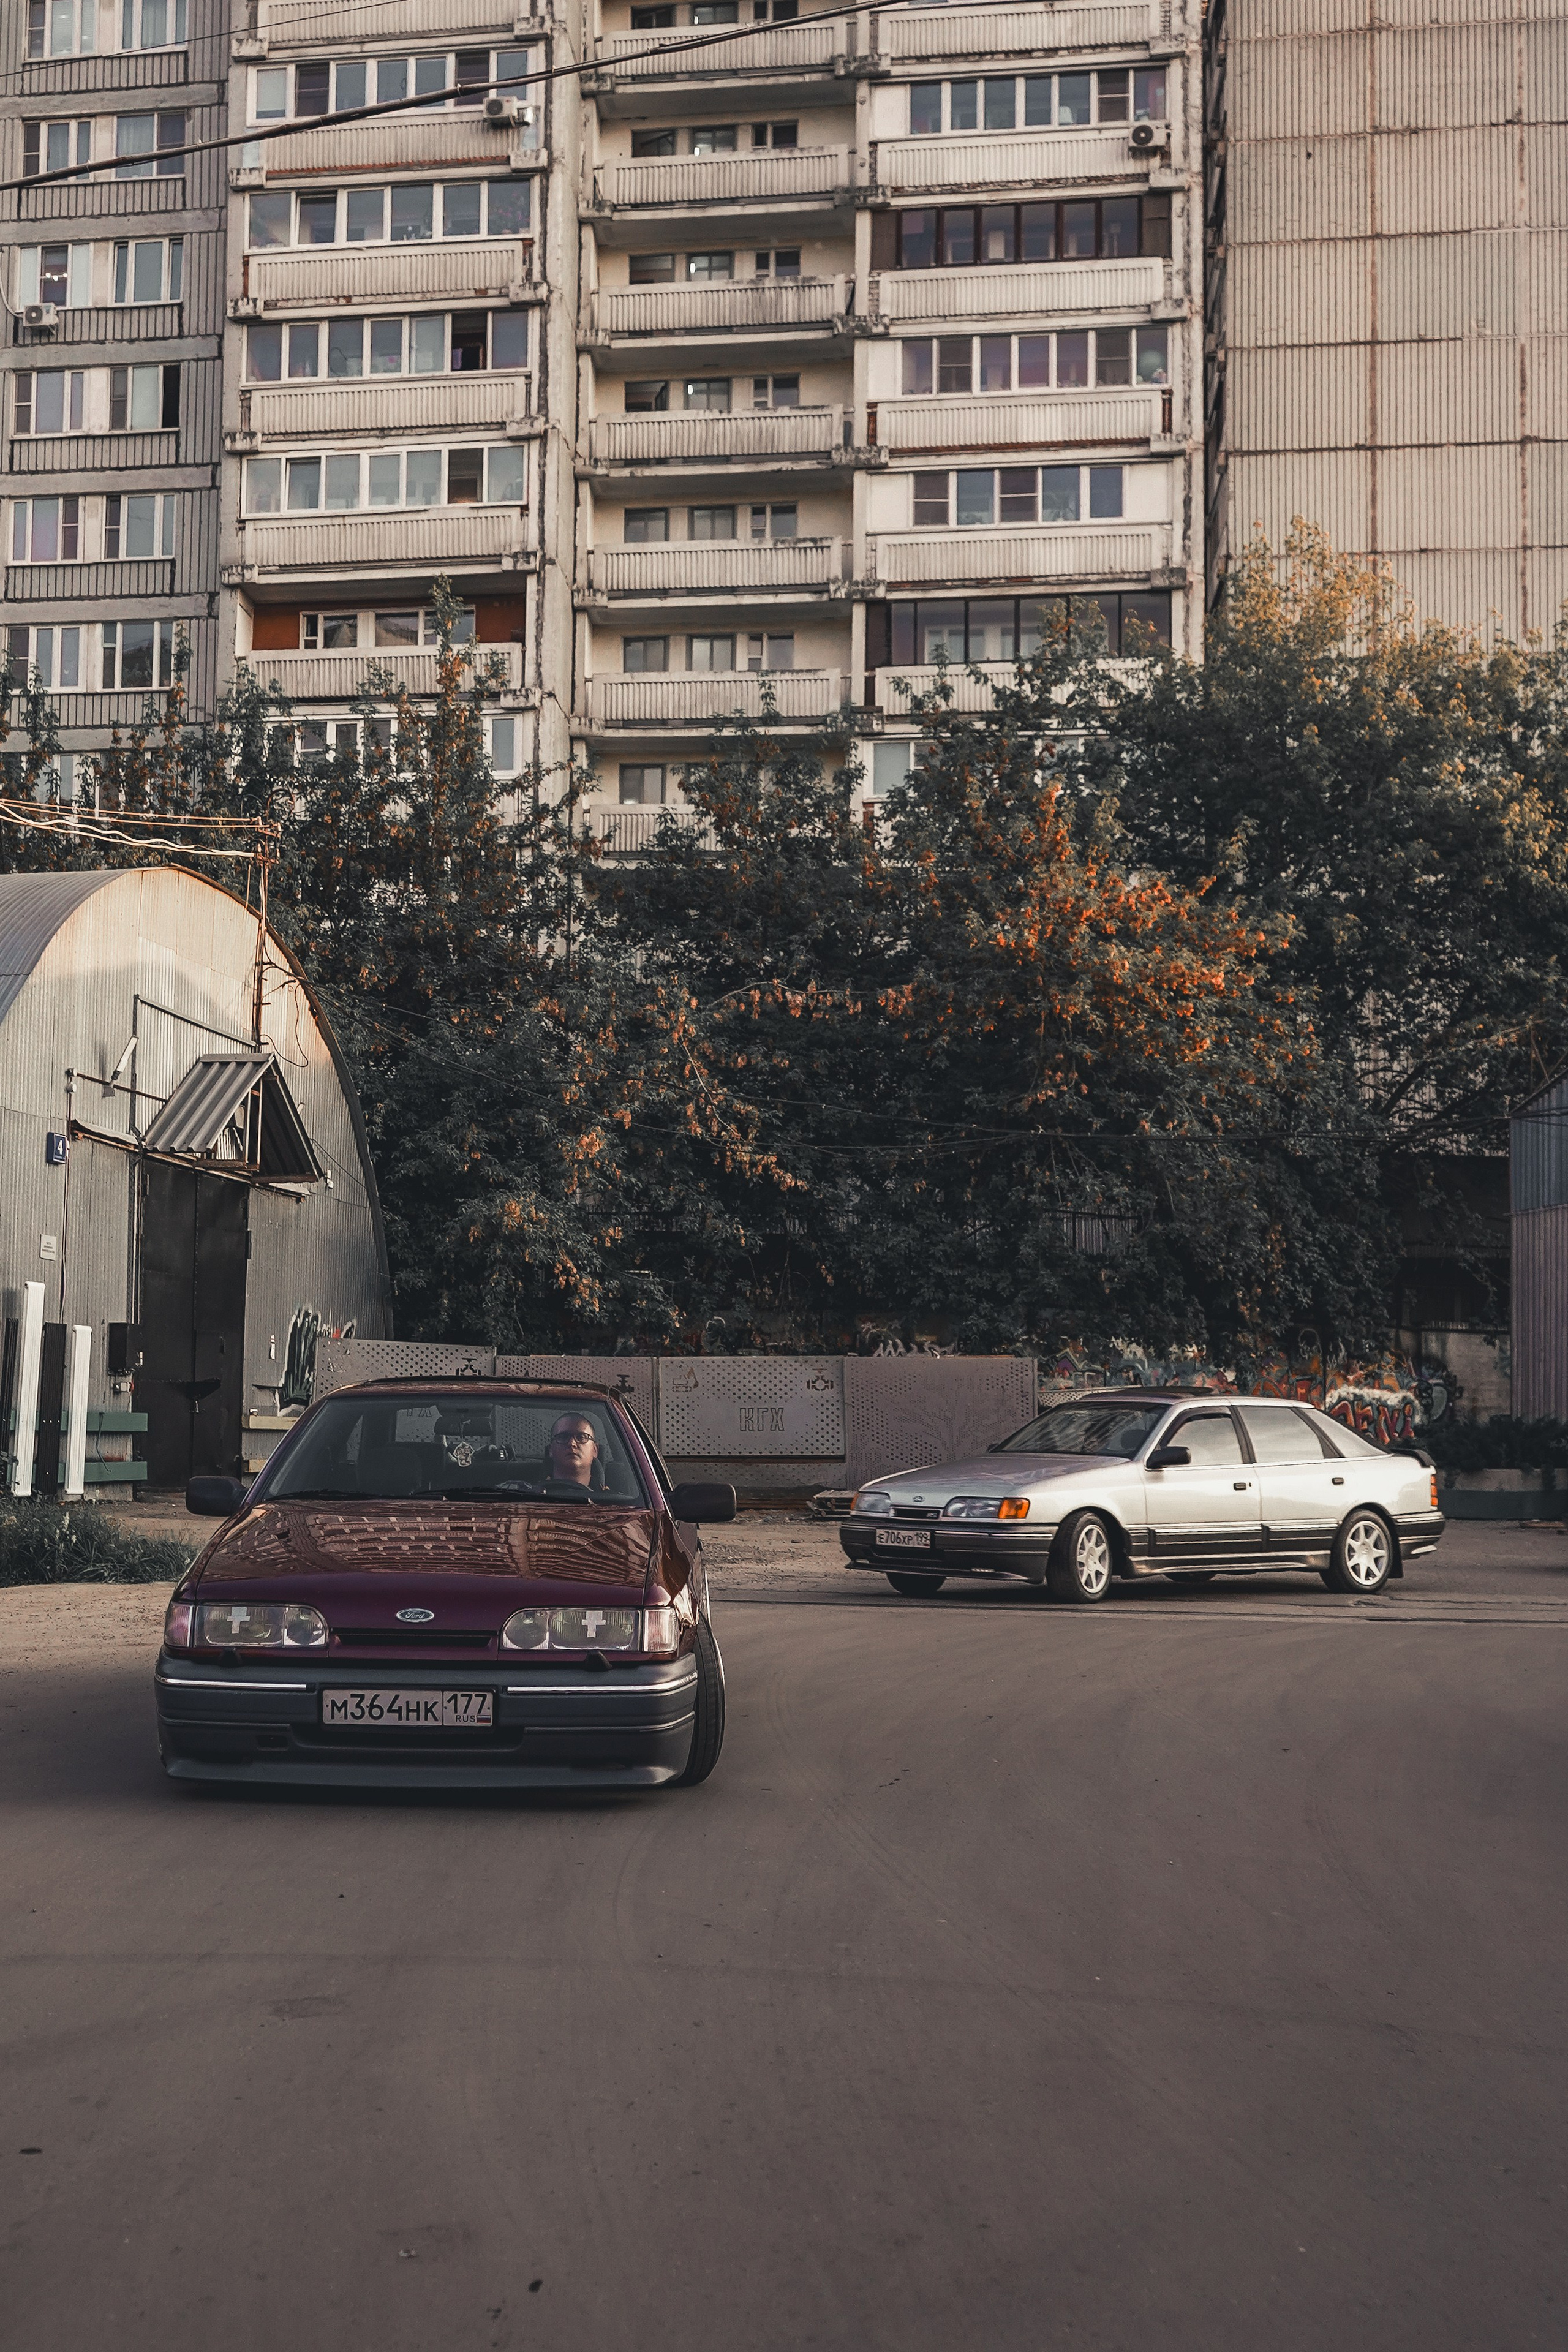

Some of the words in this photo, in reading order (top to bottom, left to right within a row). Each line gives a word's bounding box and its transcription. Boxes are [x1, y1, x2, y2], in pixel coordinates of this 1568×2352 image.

[57, 1139, 63, 1155] 4
[739, 1407, 785, 1431] КГХ
[405, 1610, 425, 1619] Ford
[446, 1693, 488, 1714] 177
[455, 1714, 475, 1723] RUS
